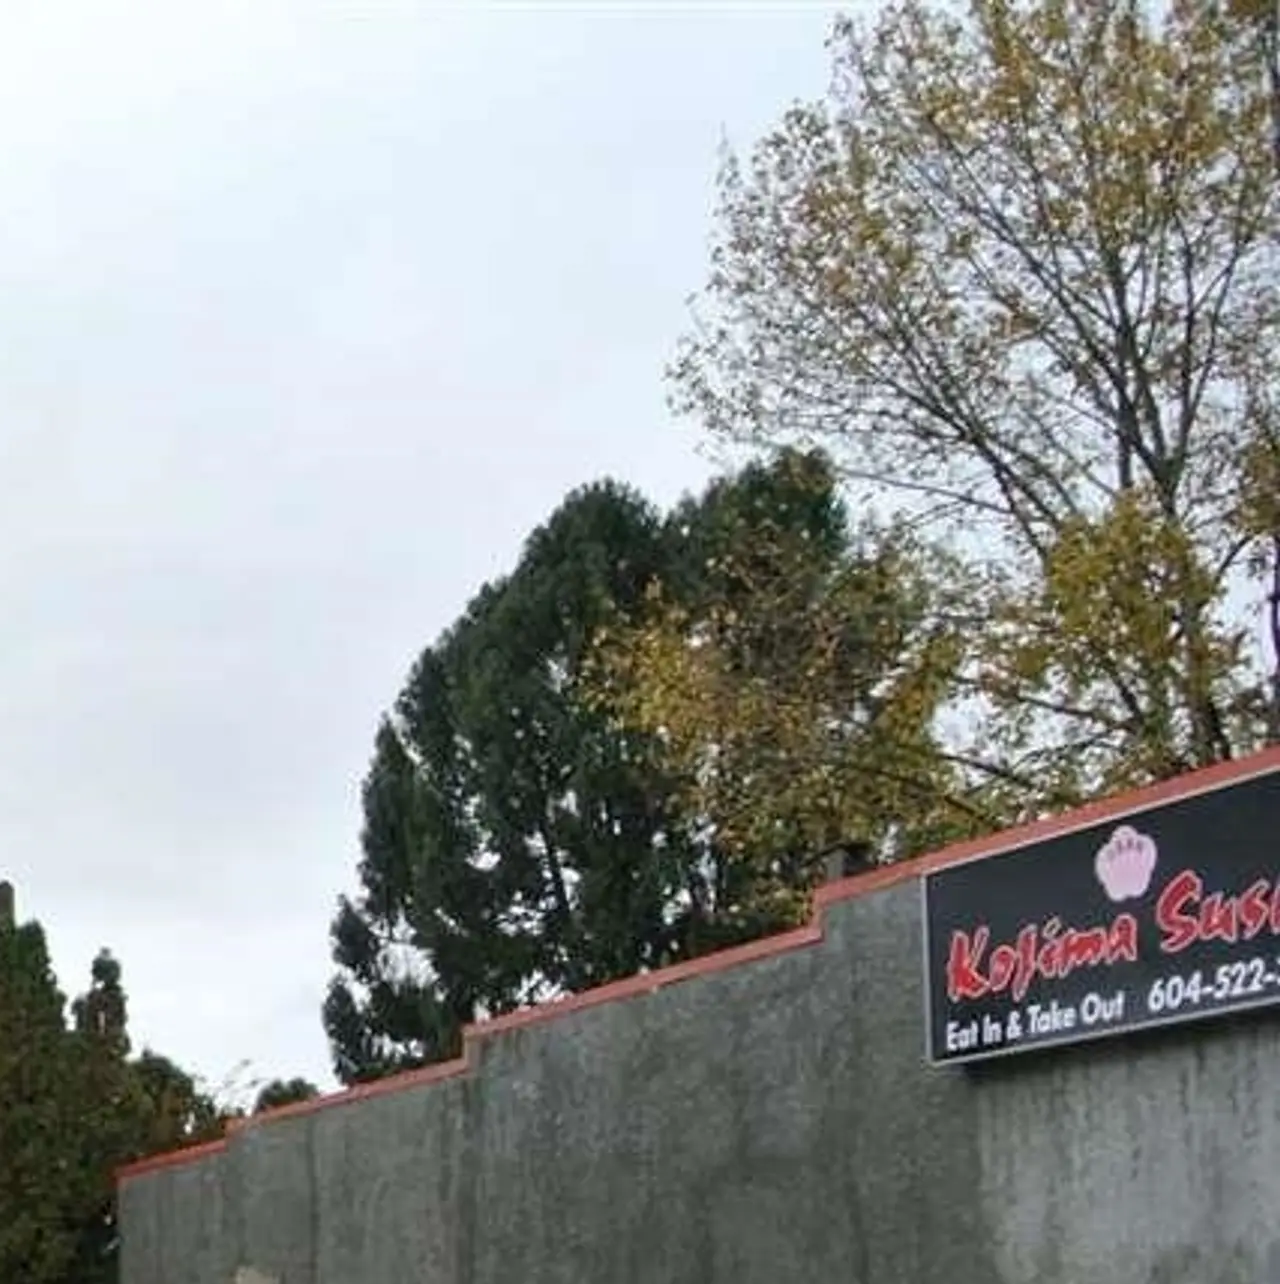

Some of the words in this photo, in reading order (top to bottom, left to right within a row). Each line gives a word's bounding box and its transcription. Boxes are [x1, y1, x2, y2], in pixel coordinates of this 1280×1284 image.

[947, 912, 1138, 1001] Kojima
[947, 1020, 978, 1051] Eat
[983, 1014, 1002, 1044] In
[1007, 1011, 1022, 1039] &
[1027, 1000, 1077, 1034] Take
[1081, 990, 1125, 1025] Out
[1148, 957, 1280, 1012] 604-522-
